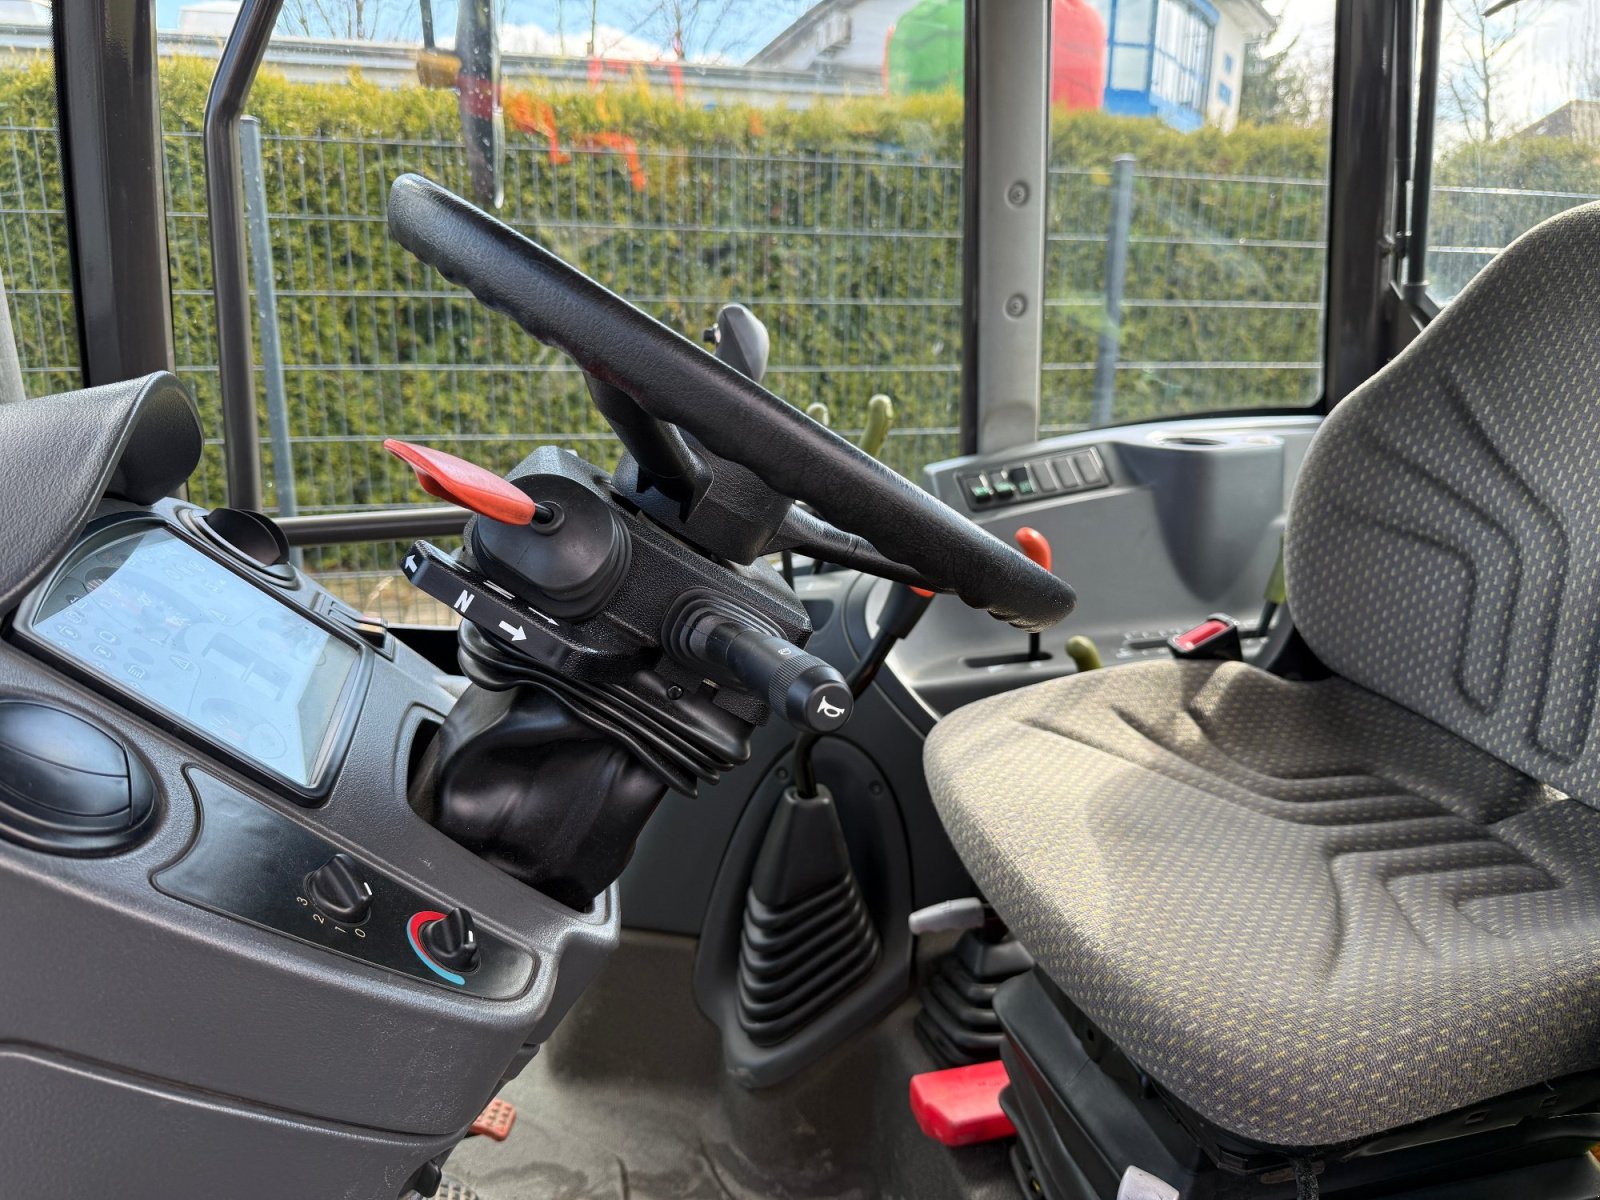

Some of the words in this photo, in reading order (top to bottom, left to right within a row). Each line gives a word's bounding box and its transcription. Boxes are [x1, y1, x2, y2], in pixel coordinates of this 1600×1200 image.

[453, 589, 475, 613] N
[296, 896, 308, 906] 3
[312, 913, 325, 925] 2
[334, 925, 347, 934] 1
